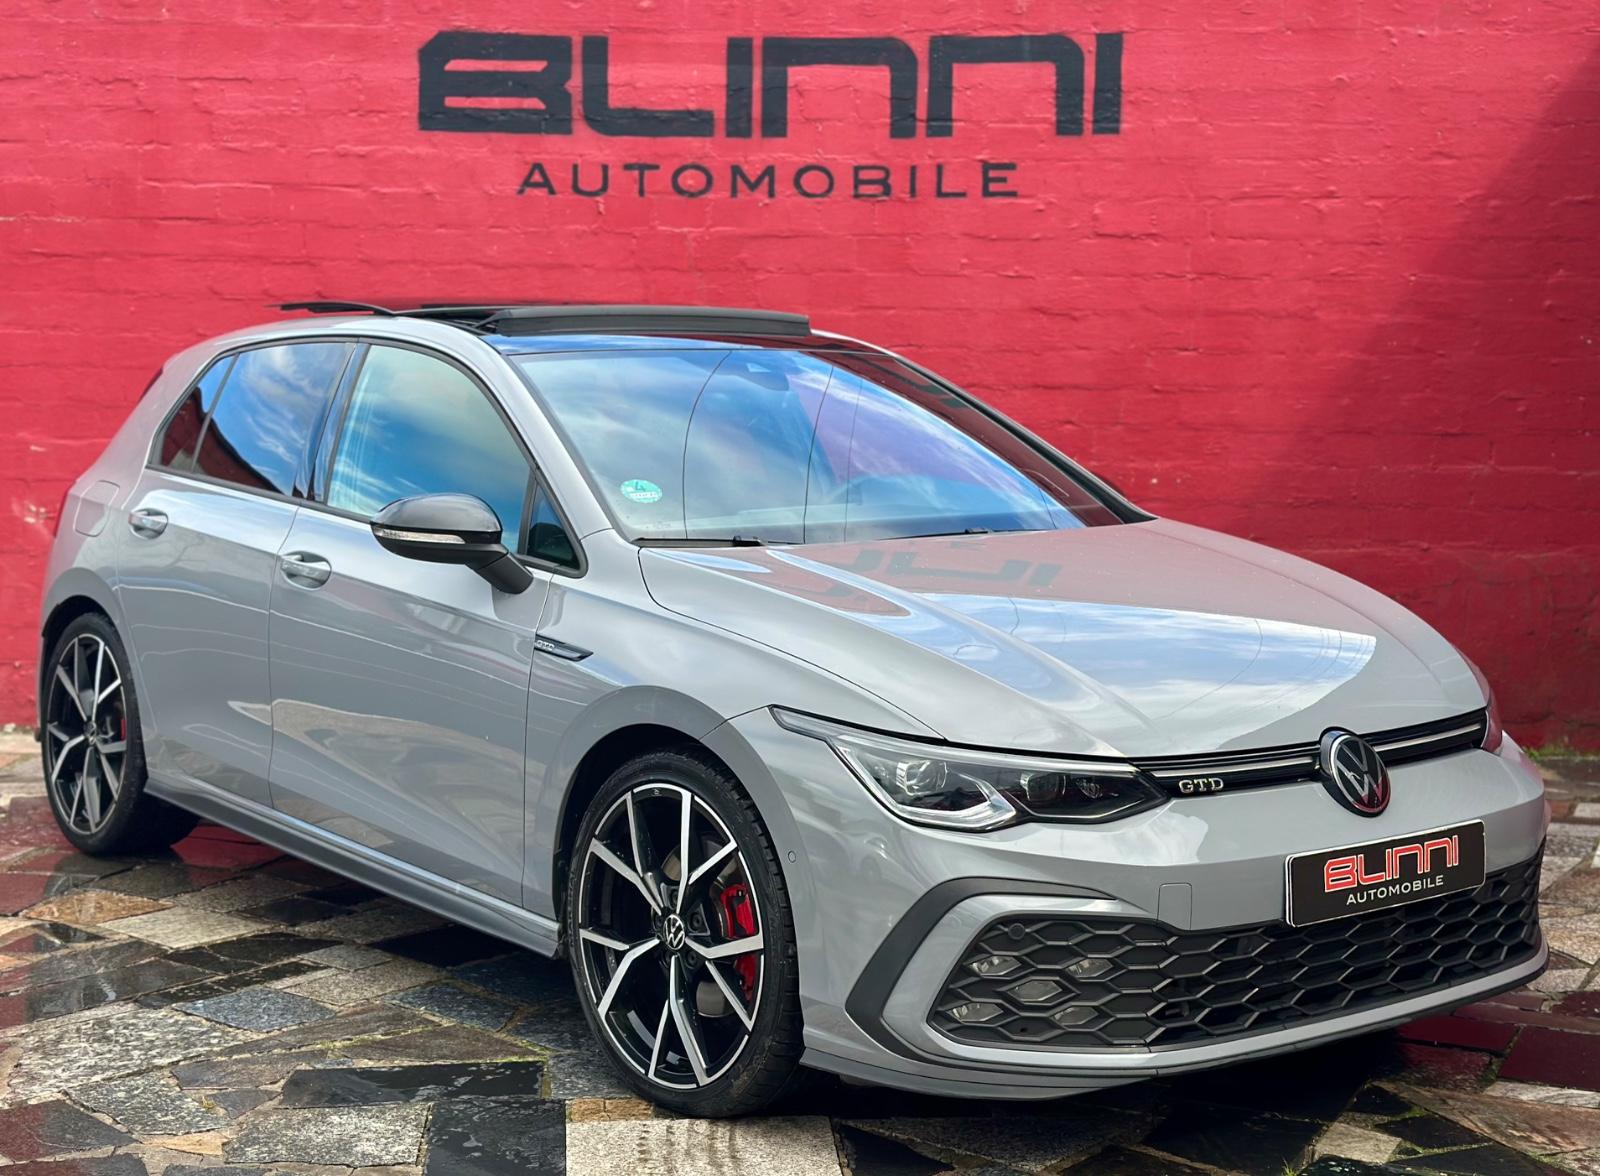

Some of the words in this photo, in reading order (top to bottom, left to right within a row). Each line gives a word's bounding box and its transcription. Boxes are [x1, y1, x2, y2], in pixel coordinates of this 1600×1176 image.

[417, 31, 1124, 139] BLINNI
[516, 161, 1019, 199] AUTOMOBILE
[1179, 777, 1224, 793] GTD
[1331, 735, 1391, 813] VW
[1324, 834, 1459, 893] BLINNI
[1346, 875, 1444, 905] AUTOMOBILE
